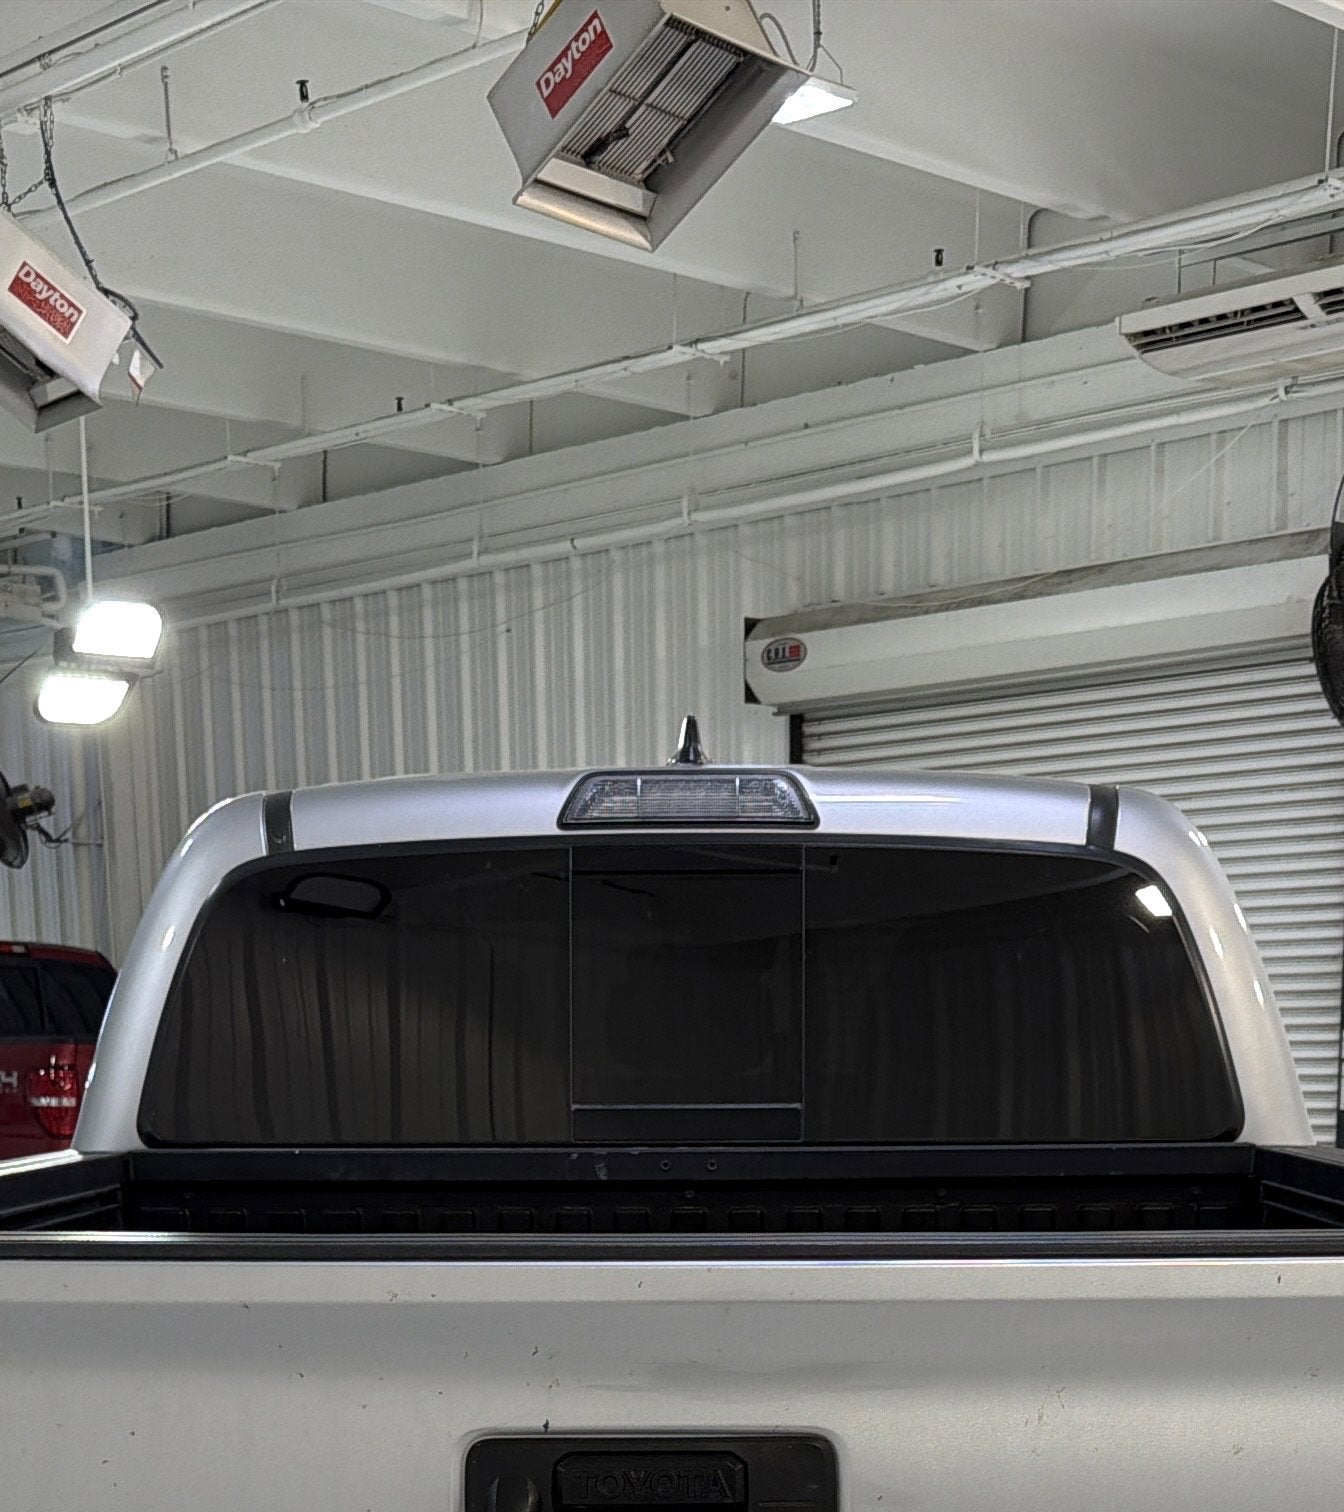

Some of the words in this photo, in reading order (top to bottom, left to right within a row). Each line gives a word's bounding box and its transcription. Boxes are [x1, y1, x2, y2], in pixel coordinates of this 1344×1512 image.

[539, 17, 603, 99] Dayton
[17, 264, 79, 323] Dayton
[574, 1469, 732, 1499] TOYOTA
